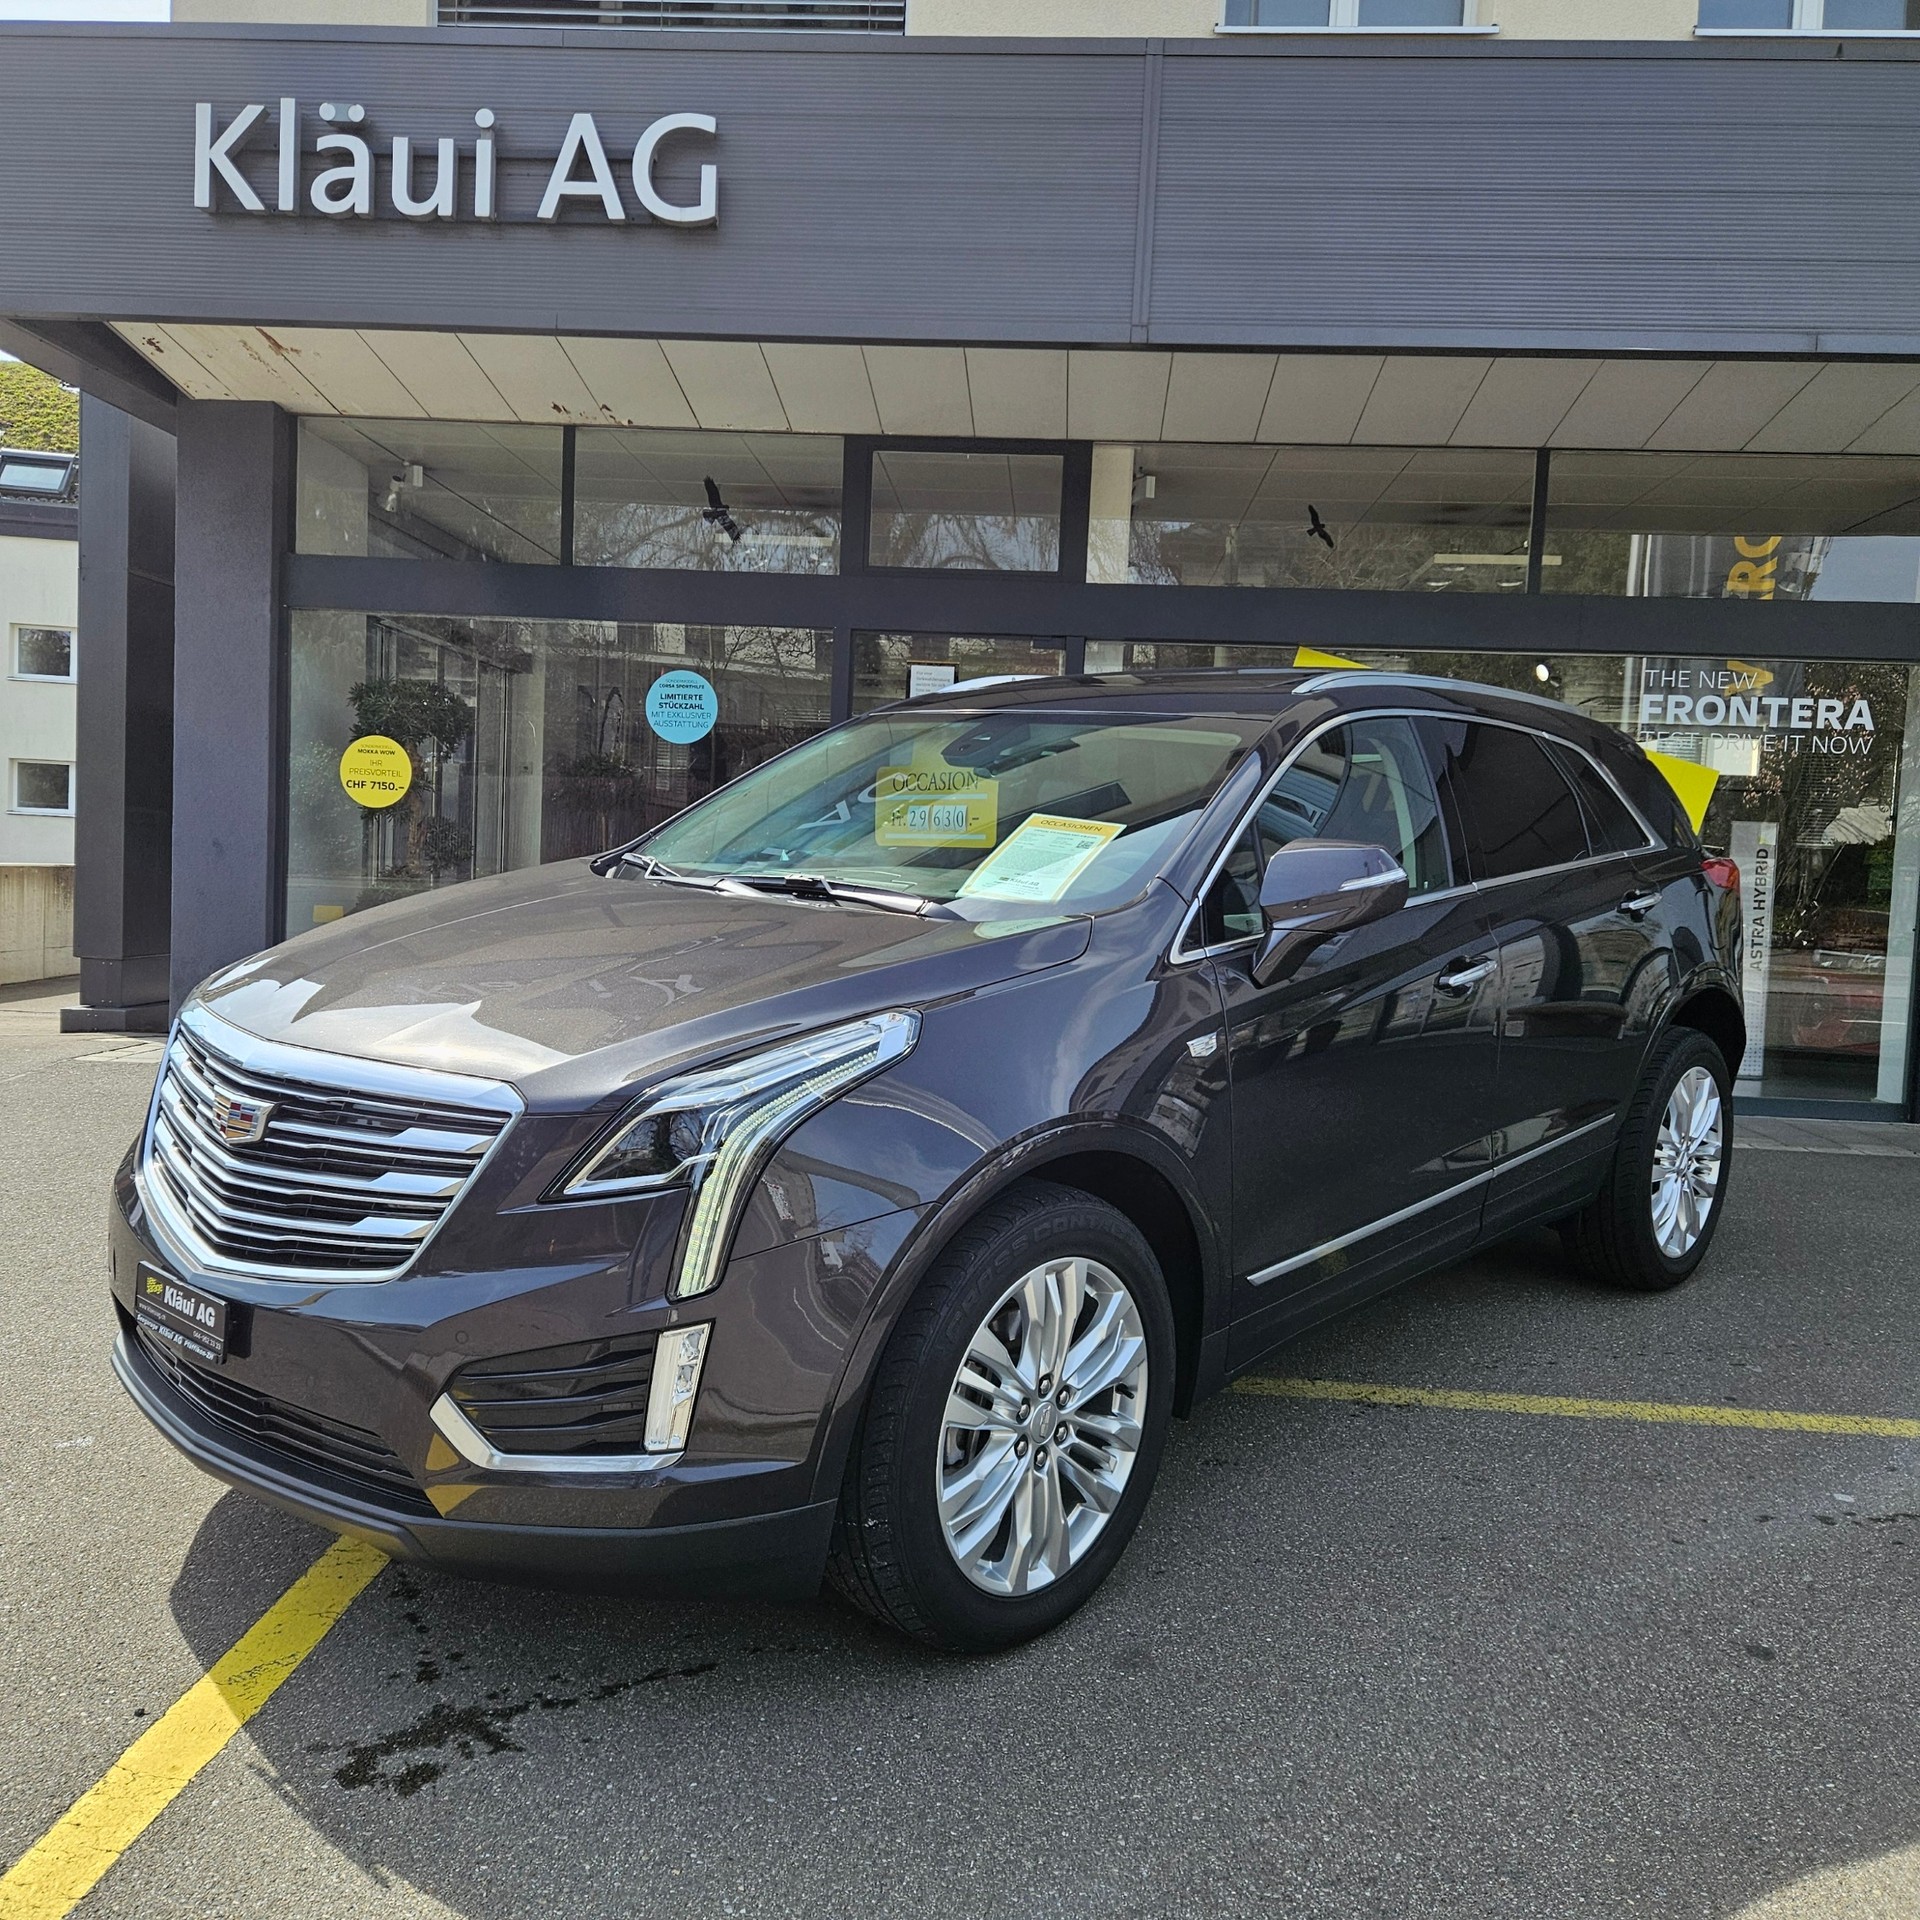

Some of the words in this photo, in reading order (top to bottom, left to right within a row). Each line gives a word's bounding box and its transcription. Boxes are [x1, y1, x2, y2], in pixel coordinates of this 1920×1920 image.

[194, 97, 497, 218] Kläui
[536, 112, 719, 228] AG
[1645, 669, 1691, 688] THE
[1699, 671, 1758, 690] NEW
[658, 701, 705, 710] STÜCKZAHL
[660, 693, 704, 701] LIMITIERTE
[667, 711, 712, 720] EXKLUSIVER
[1640, 694, 1875, 731] FRONTERA
[653, 720, 709, 729] AUSSTATTUNG
[1784, 735, 1805, 753] IT
[1812, 736, 1875, 755] NOW
[349, 767, 403, 778] PREISVORTEIL
[892, 771, 979, 792] OCCASION
[346, 780, 367, 789] CHF
[1040, 819, 1103, 832] OCCASIONEN
[1752, 848, 1769, 910] HYBRID
[1750, 916, 1765, 971] ASTRA
[163, 1285, 196, 1317] Kläui
[196, 1302, 216, 1328] AG
